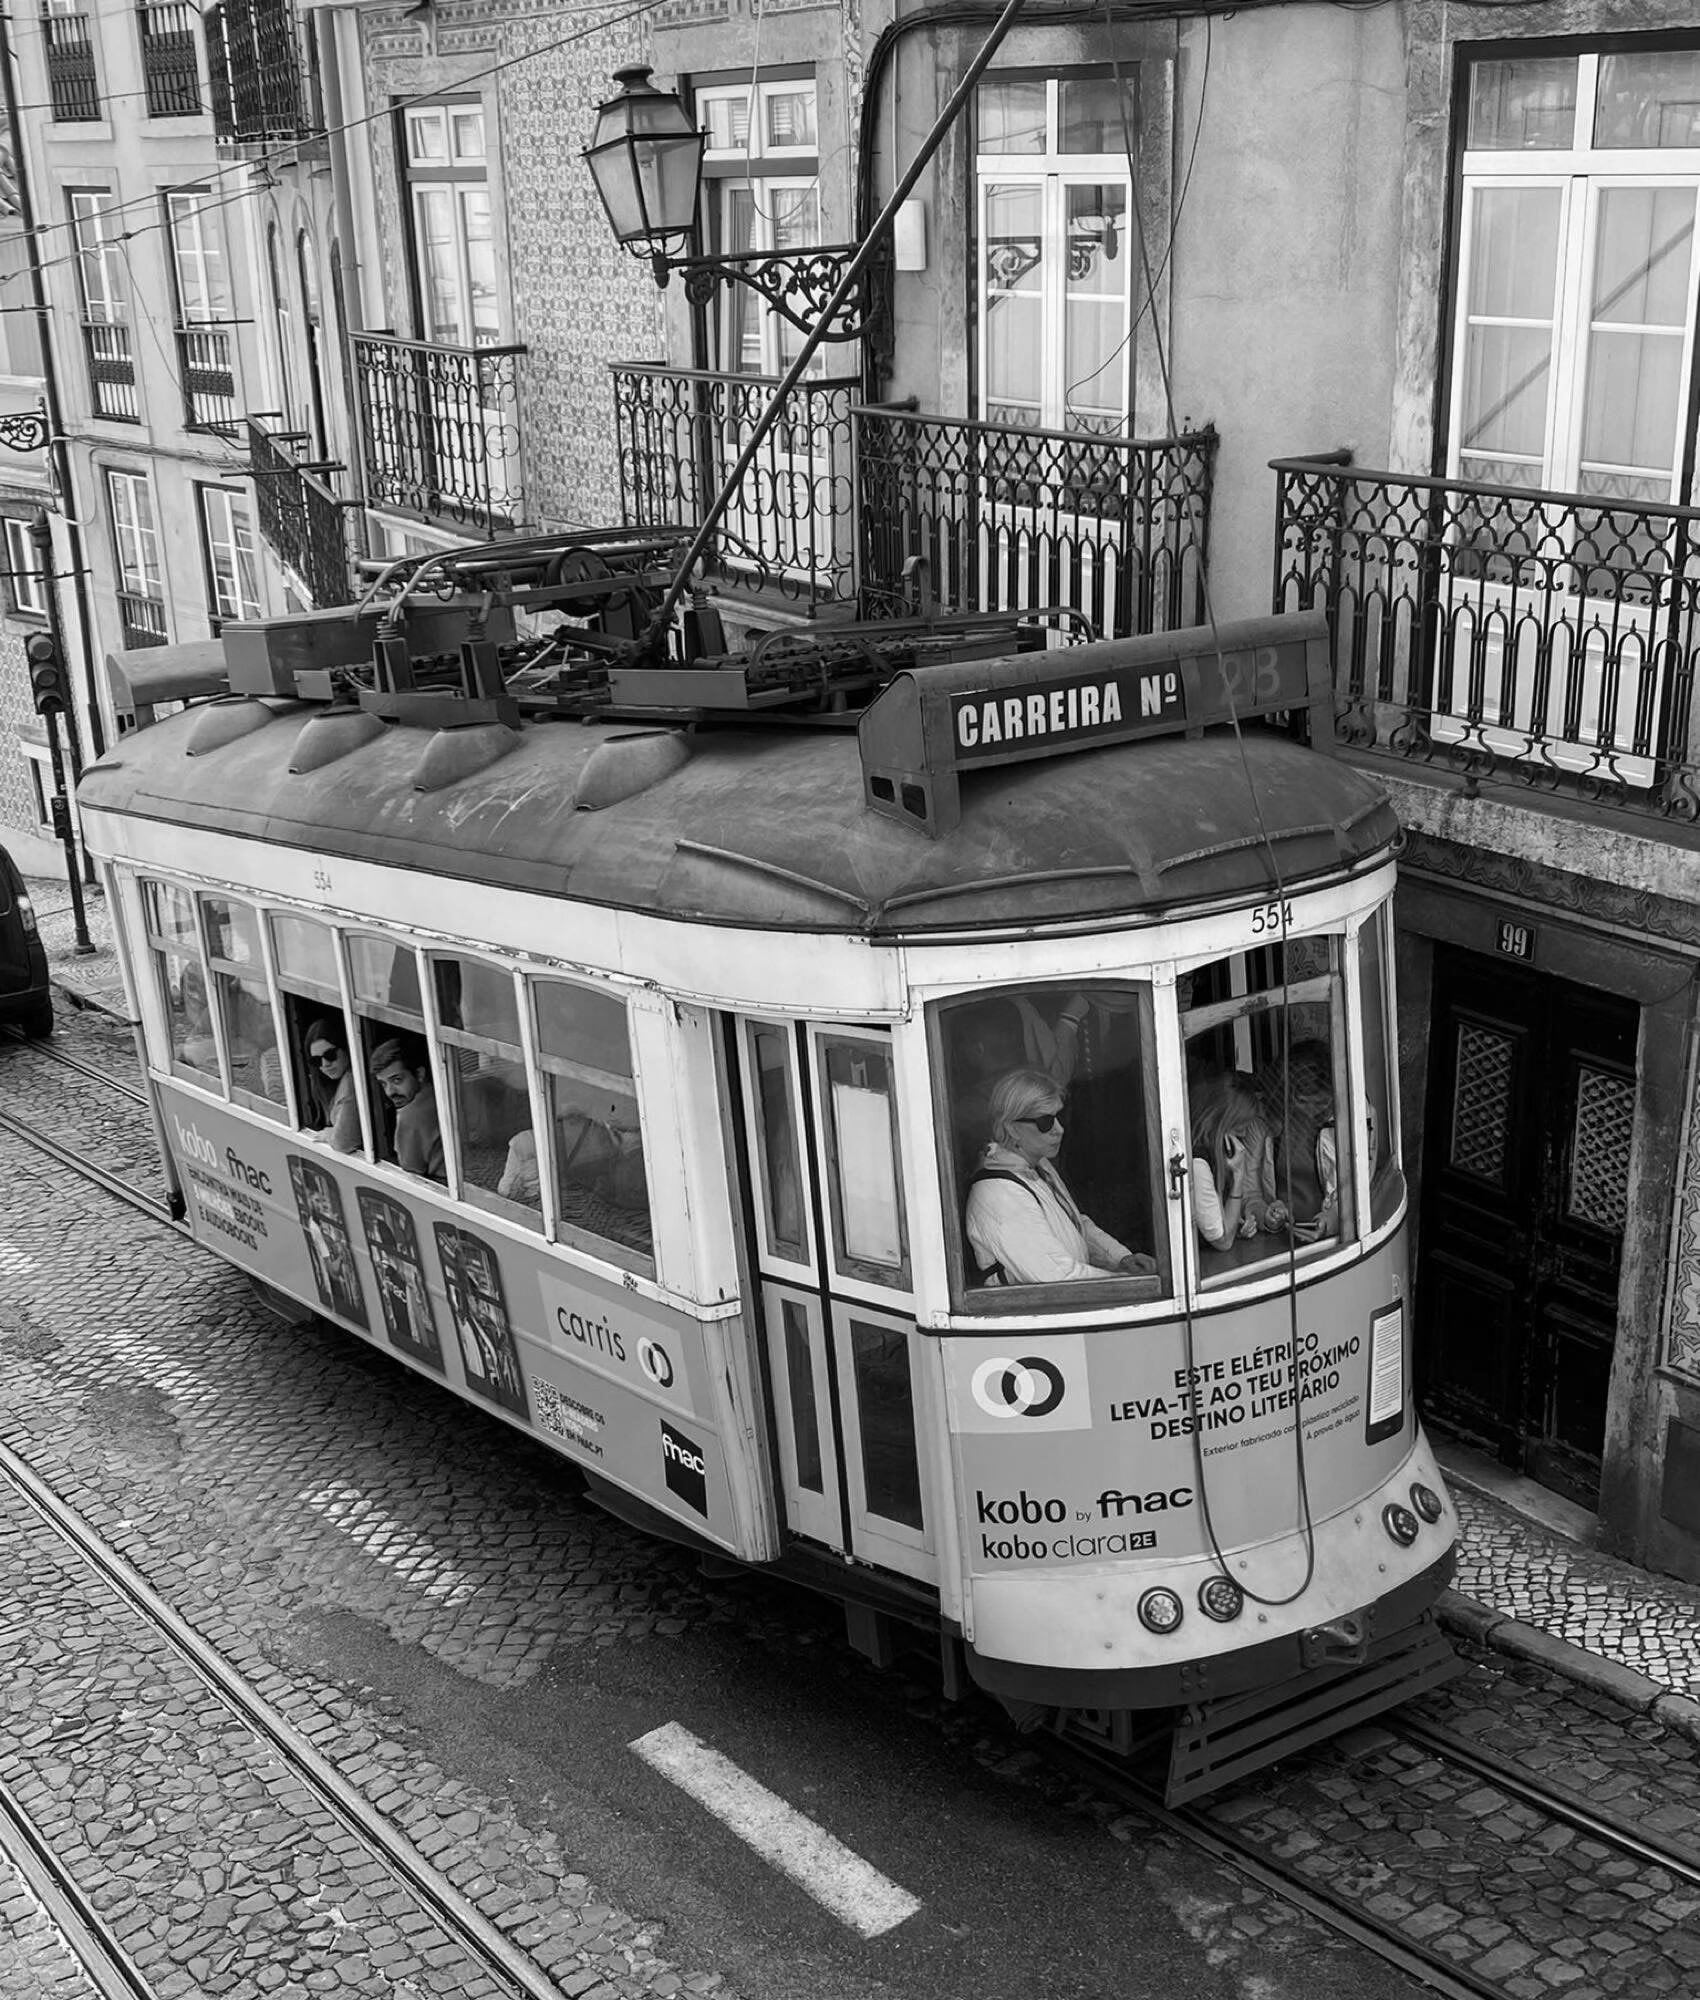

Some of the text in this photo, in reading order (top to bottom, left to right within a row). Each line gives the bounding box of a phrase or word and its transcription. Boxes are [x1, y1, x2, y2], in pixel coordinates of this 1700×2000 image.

[957, 681, 1122, 747] CARREIRA
[1140, 671, 1177, 718] Nº
[1252, 901, 1294, 933] 554
[1502, 923, 1527, 956] 99
[174, 1113, 217, 1169] kobo
[226, 1146, 272, 1195] fnac
[557, 1306, 626, 1362] carris
[1174, 1333, 1318, 1388] ESTE ELÉTRICO
[1110, 1390, 1204, 1421] LEVA-TE
[1210, 1382, 1242, 1406] AO
[1247, 1369, 1282, 1395] TEU
[1150, 1405, 1245, 1440] DESTINO
[663, 1433, 705, 1475] fnac
[1203, 1442, 1238, 1457] Exterior
[1240, 1429, 1282, 1448] fabricado
[976, 1487, 1193, 1524] kobo by fnac
[982, 1532, 1156, 1559] kobo clara 2E
